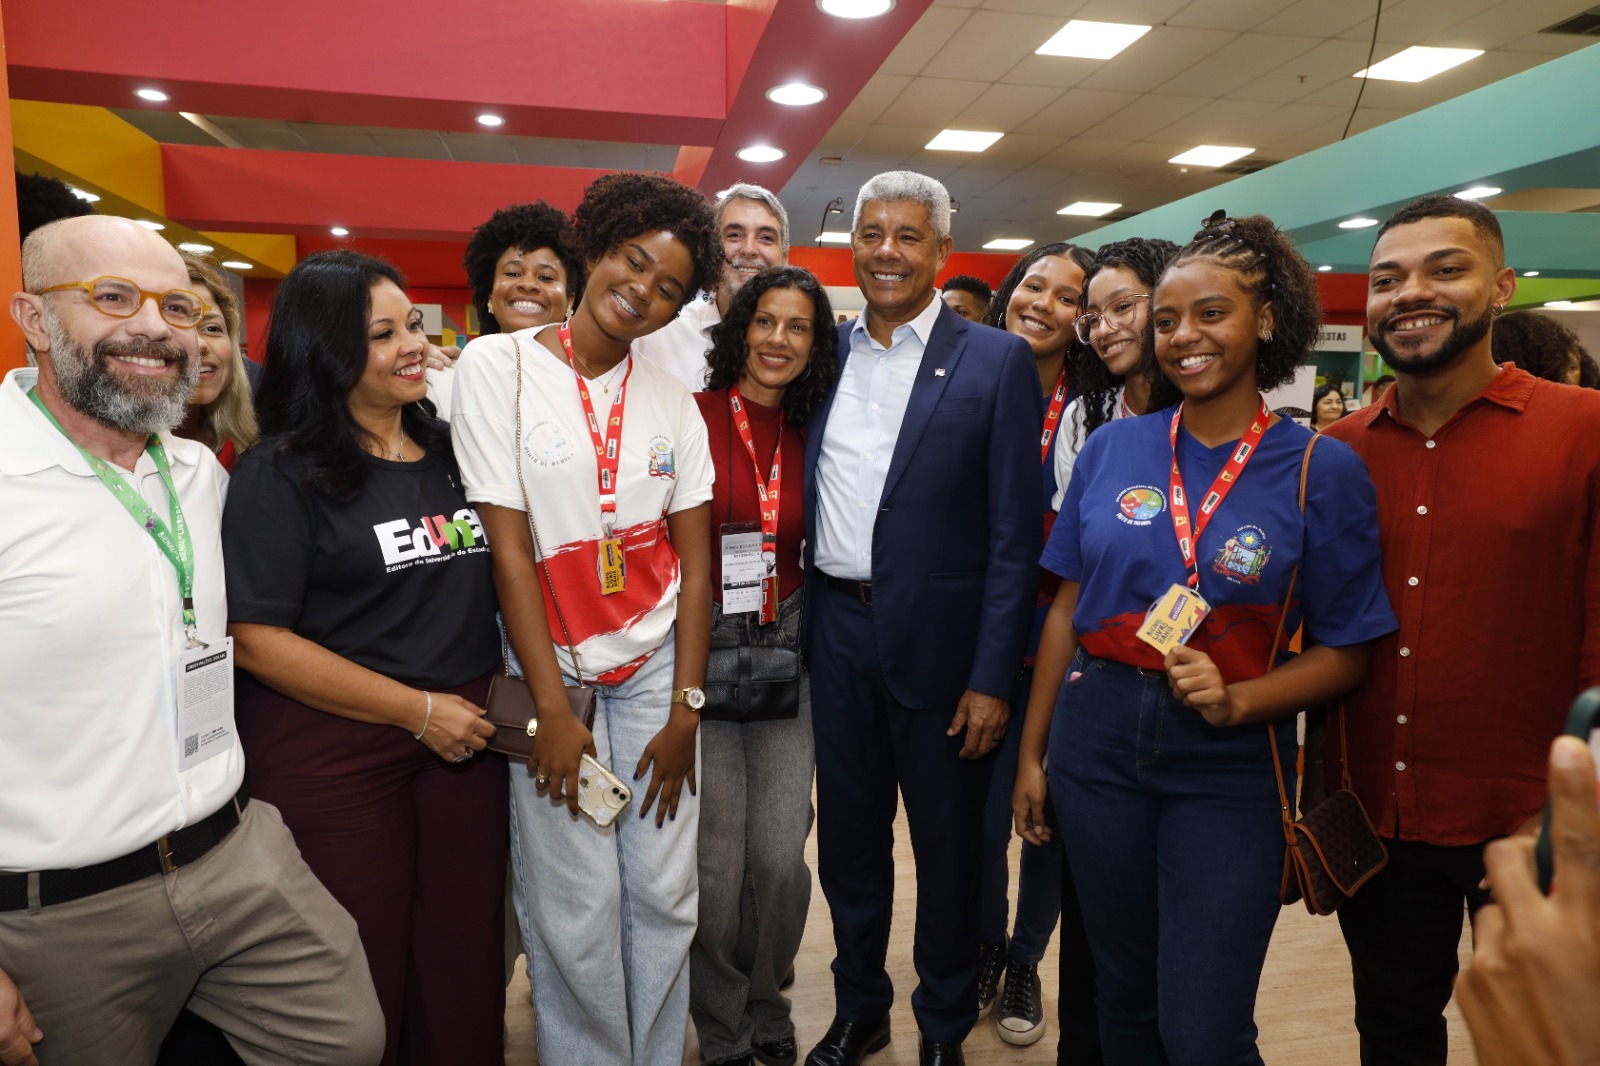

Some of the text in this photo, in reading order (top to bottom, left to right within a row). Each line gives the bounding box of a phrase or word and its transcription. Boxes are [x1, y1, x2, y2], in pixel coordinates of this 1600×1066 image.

[157, 531, 175, 554] BIENAL
[386, 561, 413, 573] Editora
[1157, 626, 1174, 645] BAHIA
